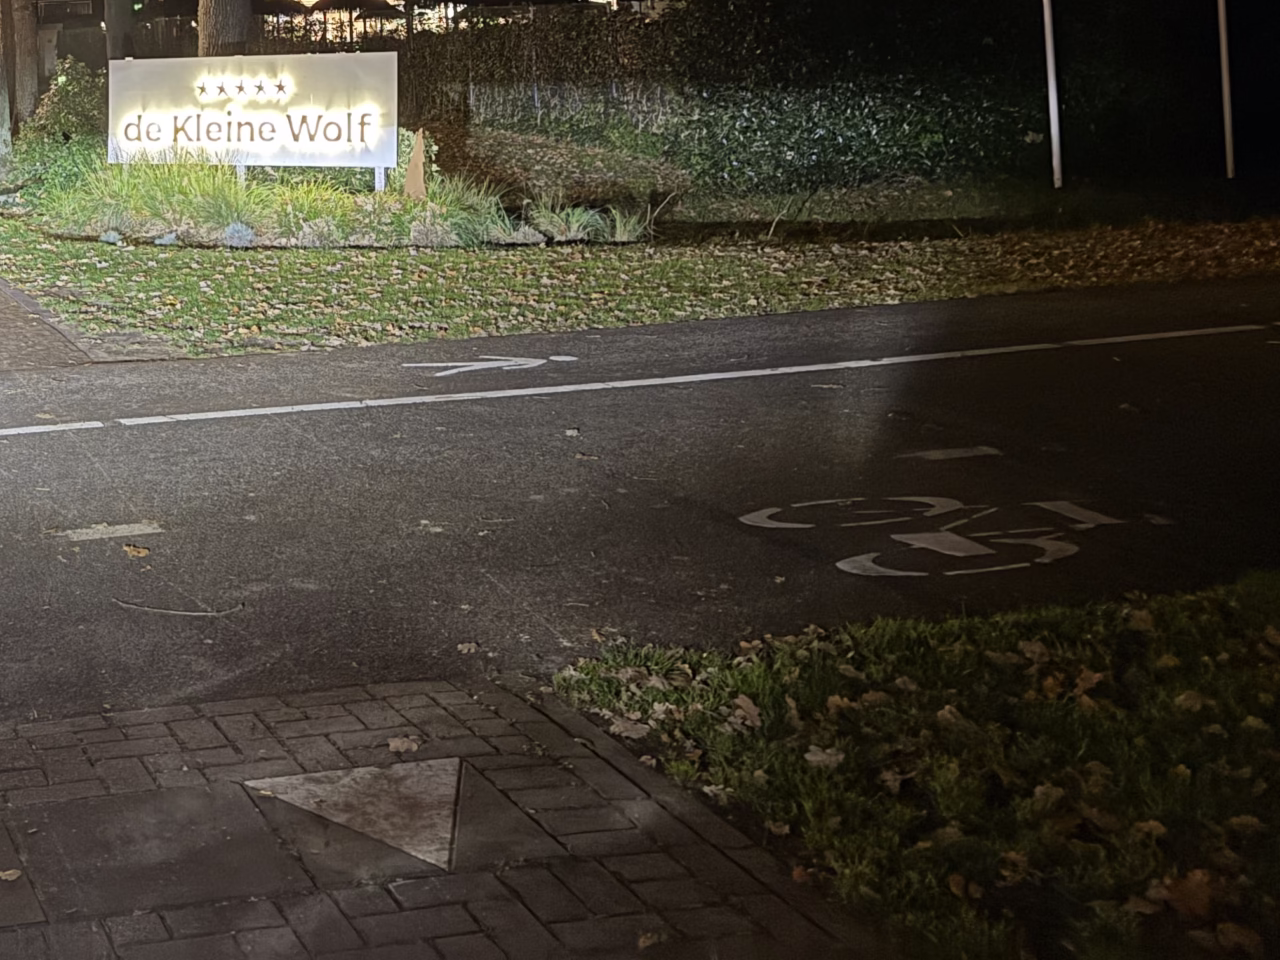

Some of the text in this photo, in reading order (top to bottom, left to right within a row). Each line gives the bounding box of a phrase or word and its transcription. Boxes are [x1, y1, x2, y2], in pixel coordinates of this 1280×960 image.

[124, 110, 372, 143] de Kleine Wolf
